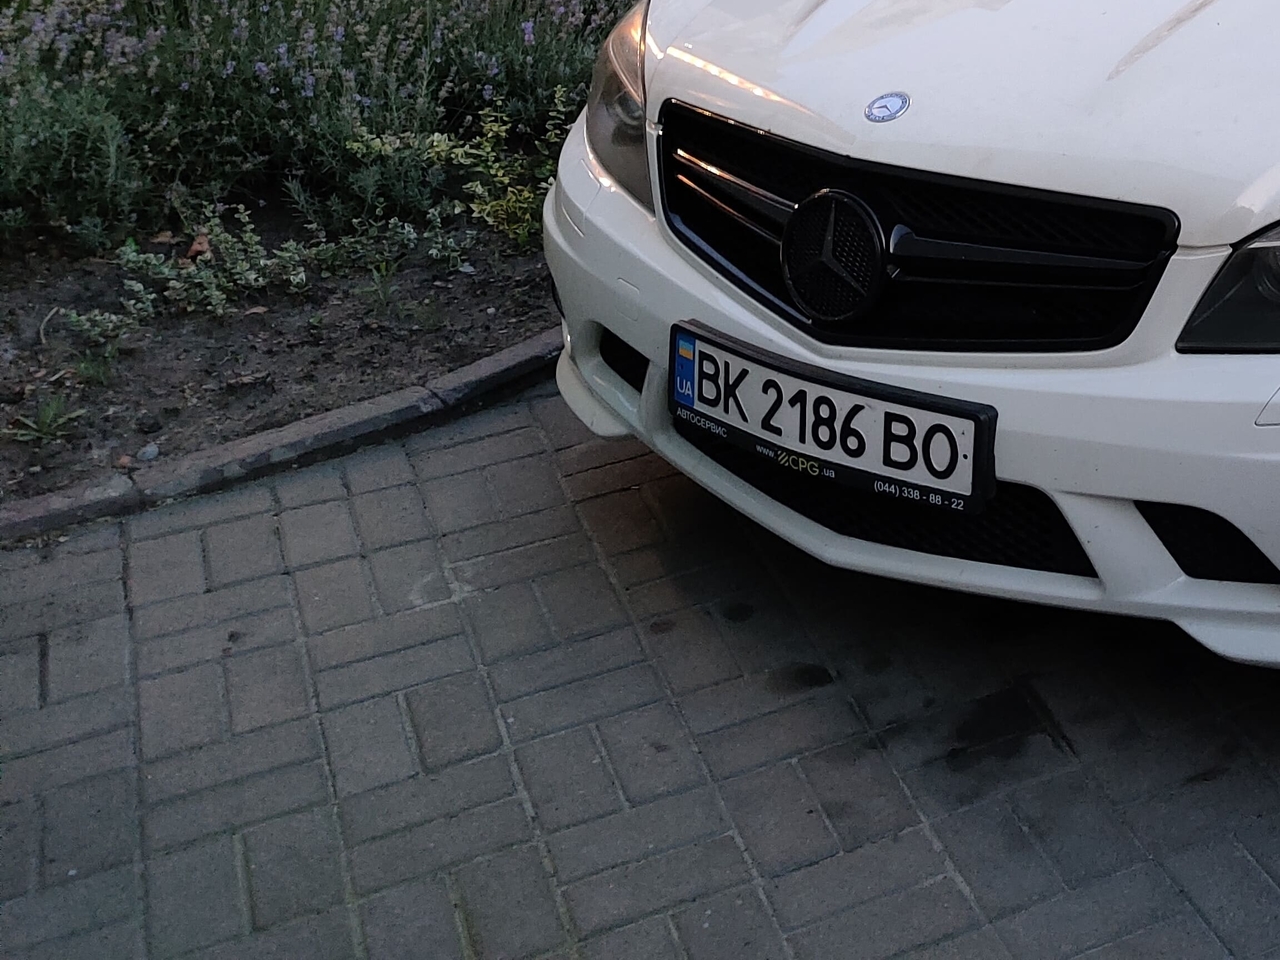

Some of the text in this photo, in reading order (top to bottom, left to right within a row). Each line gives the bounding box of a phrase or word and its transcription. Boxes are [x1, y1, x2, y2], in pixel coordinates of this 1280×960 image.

[676, 376, 693, 398] UA
[676, 407, 728, 438] АВТОСЕРВИС
[697, 349, 959, 480] BK 2186 BO
[874, 480, 900, 497] (044)
[902, 487, 920, 500] 338
[929, 493, 942, 505] 88
[951, 498, 964, 510] 22
